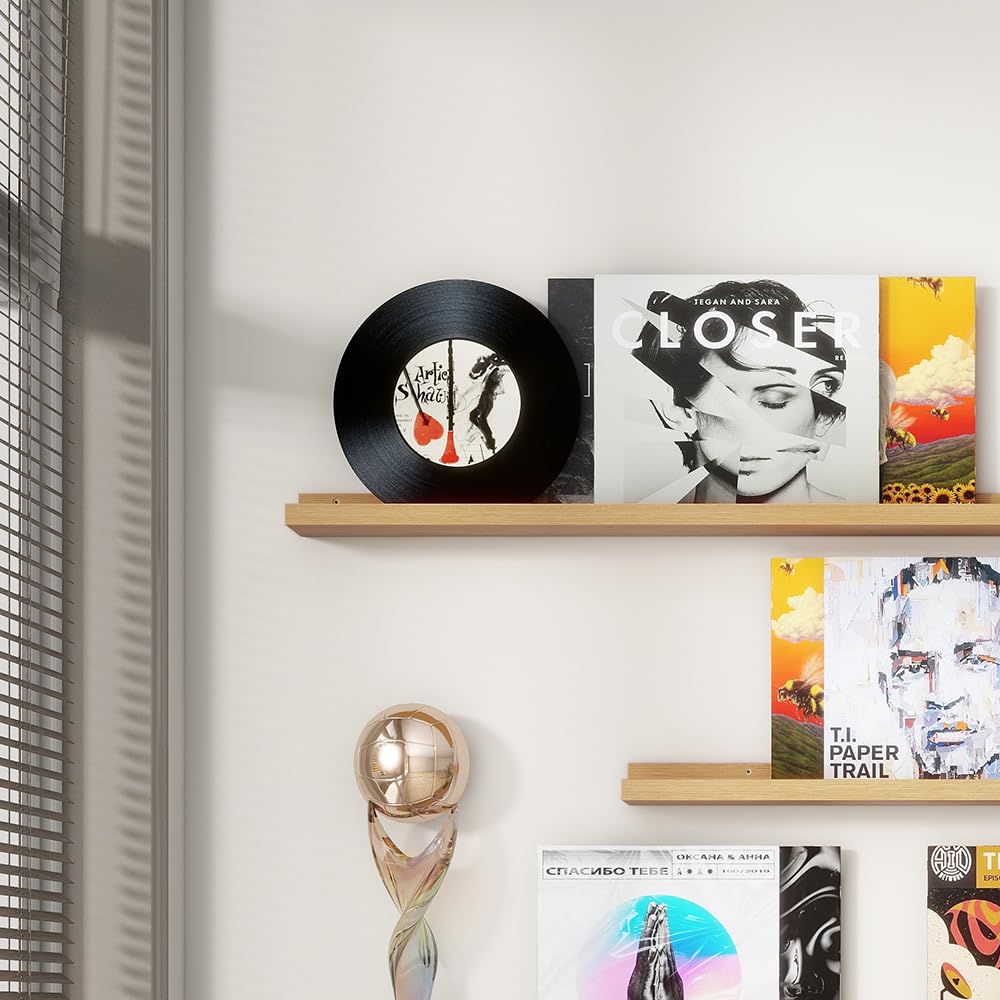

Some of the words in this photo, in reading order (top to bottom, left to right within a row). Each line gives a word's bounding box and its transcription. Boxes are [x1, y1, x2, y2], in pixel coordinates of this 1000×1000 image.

[612, 311, 862, 349] CLOSER
[830, 727, 856, 743] T.I.
[830, 745, 899, 760] PAPER
[830, 763, 889, 778] TRAIL
[546, 867, 626, 876] СПАСИБО
[629, 867, 669, 876] ТЕБЕ
